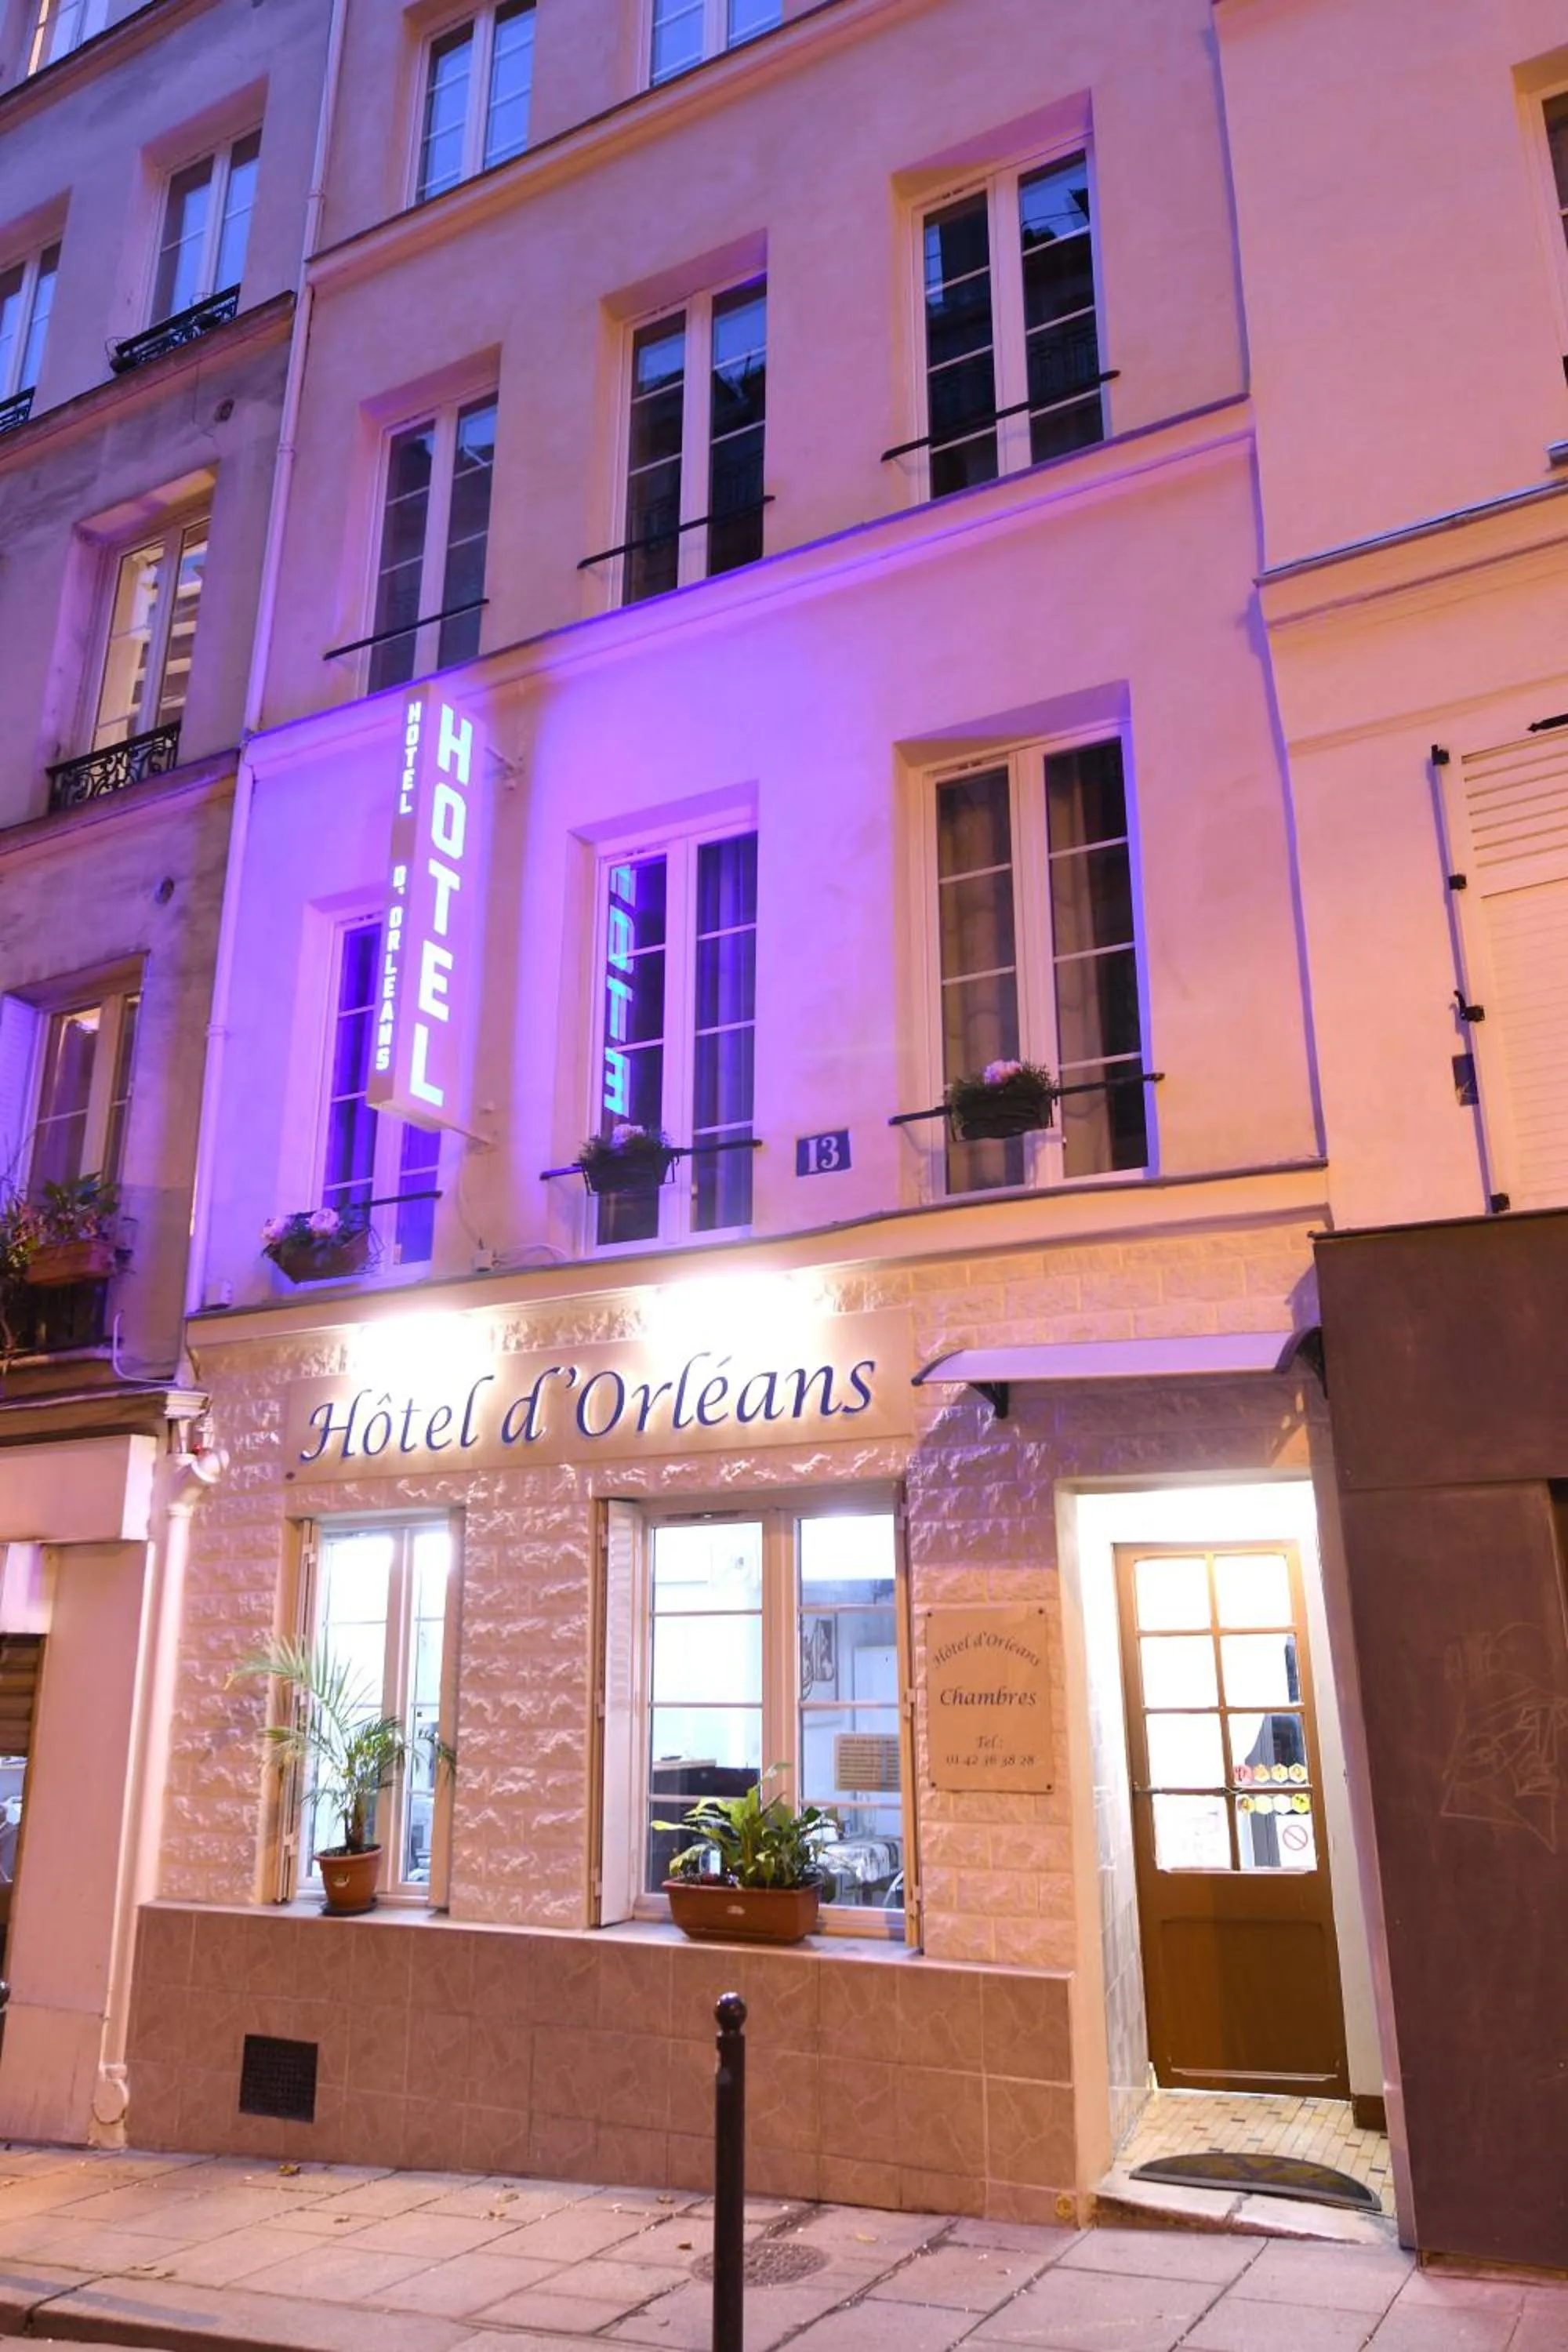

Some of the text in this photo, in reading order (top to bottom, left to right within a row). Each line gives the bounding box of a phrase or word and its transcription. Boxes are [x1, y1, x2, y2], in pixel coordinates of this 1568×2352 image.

[398, 702, 422, 815] HOTEL
[409, 704, 473, 1108] HOTEL
[808, 1136, 840, 1173] 13
[300, 1352, 877, 1465] Hôtel d'Orléans
[940, 1685, 1037, 1707] Chambres
